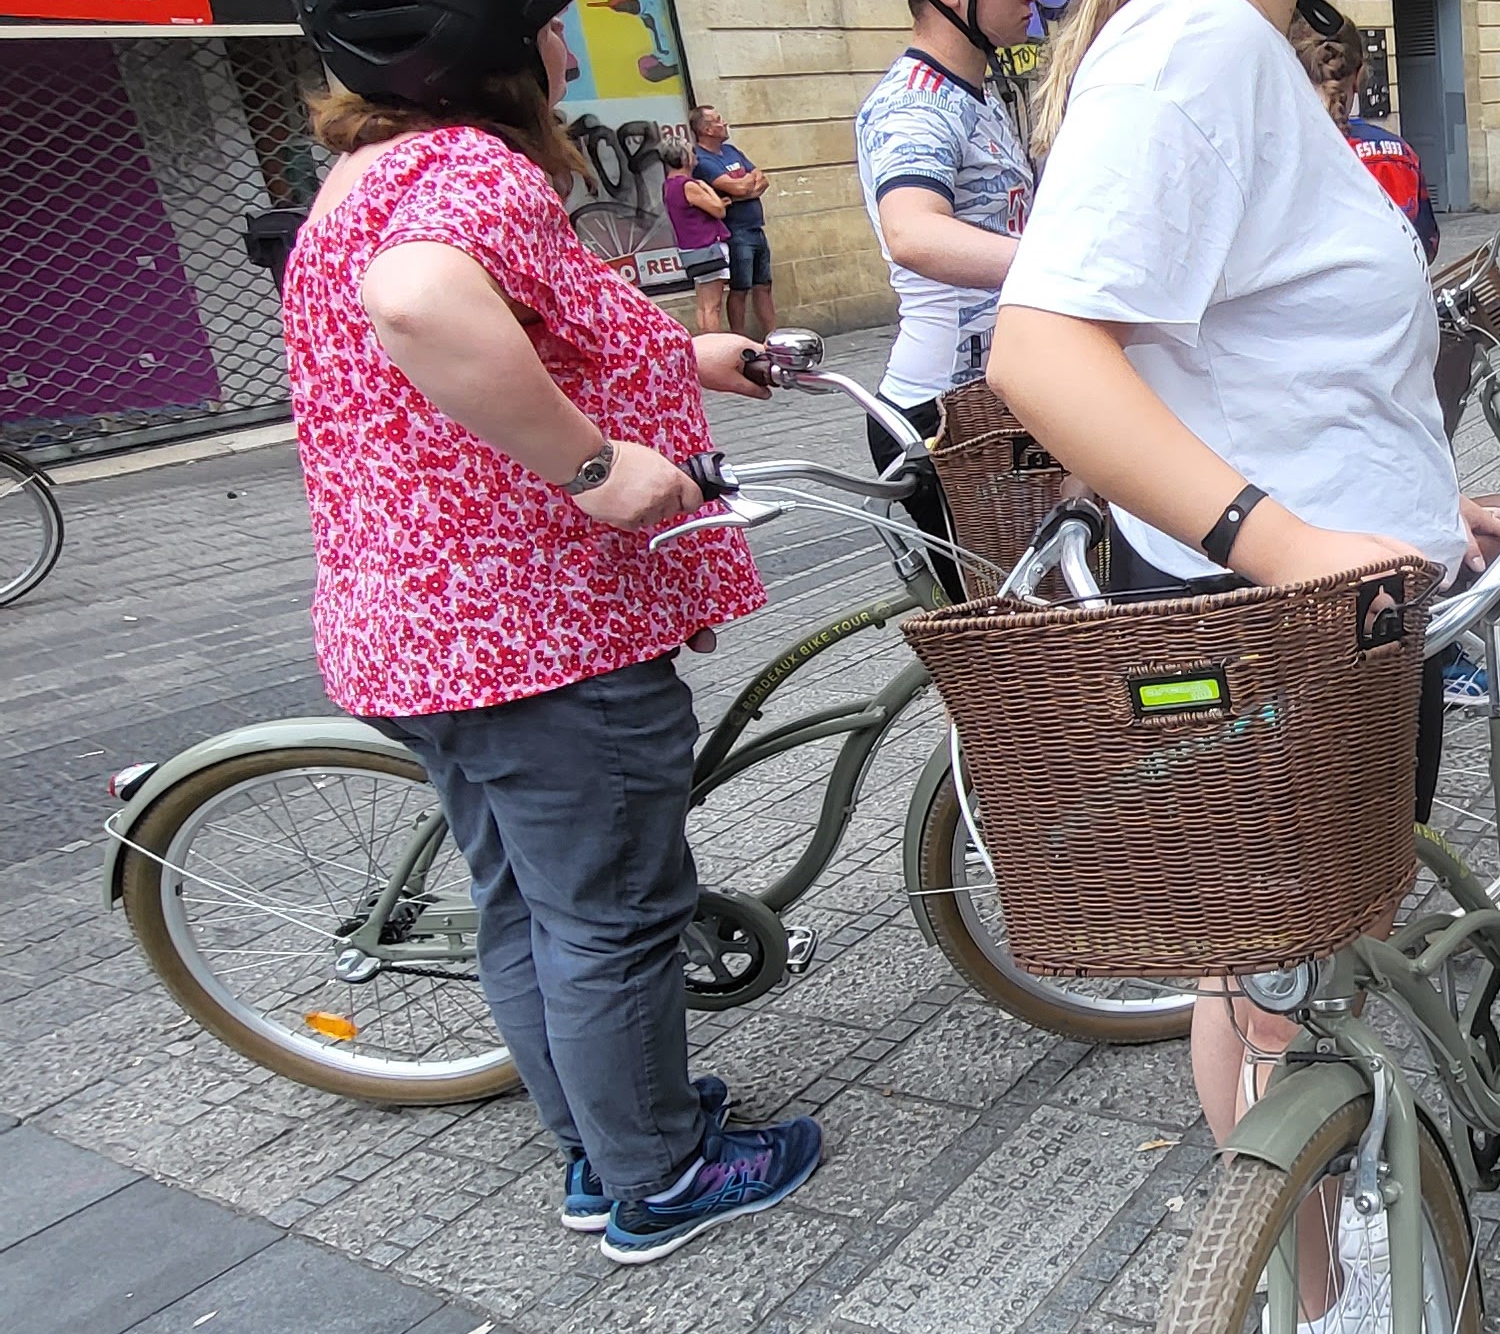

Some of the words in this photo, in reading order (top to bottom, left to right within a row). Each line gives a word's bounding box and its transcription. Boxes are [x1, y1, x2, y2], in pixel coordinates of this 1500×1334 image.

[741, 652, 799, 710] BORDEAUX
[799, 631, 831, 657] BIKE
[832, 611, 872, 636] TOUR
[892, 1278, 927, 1312] LA
